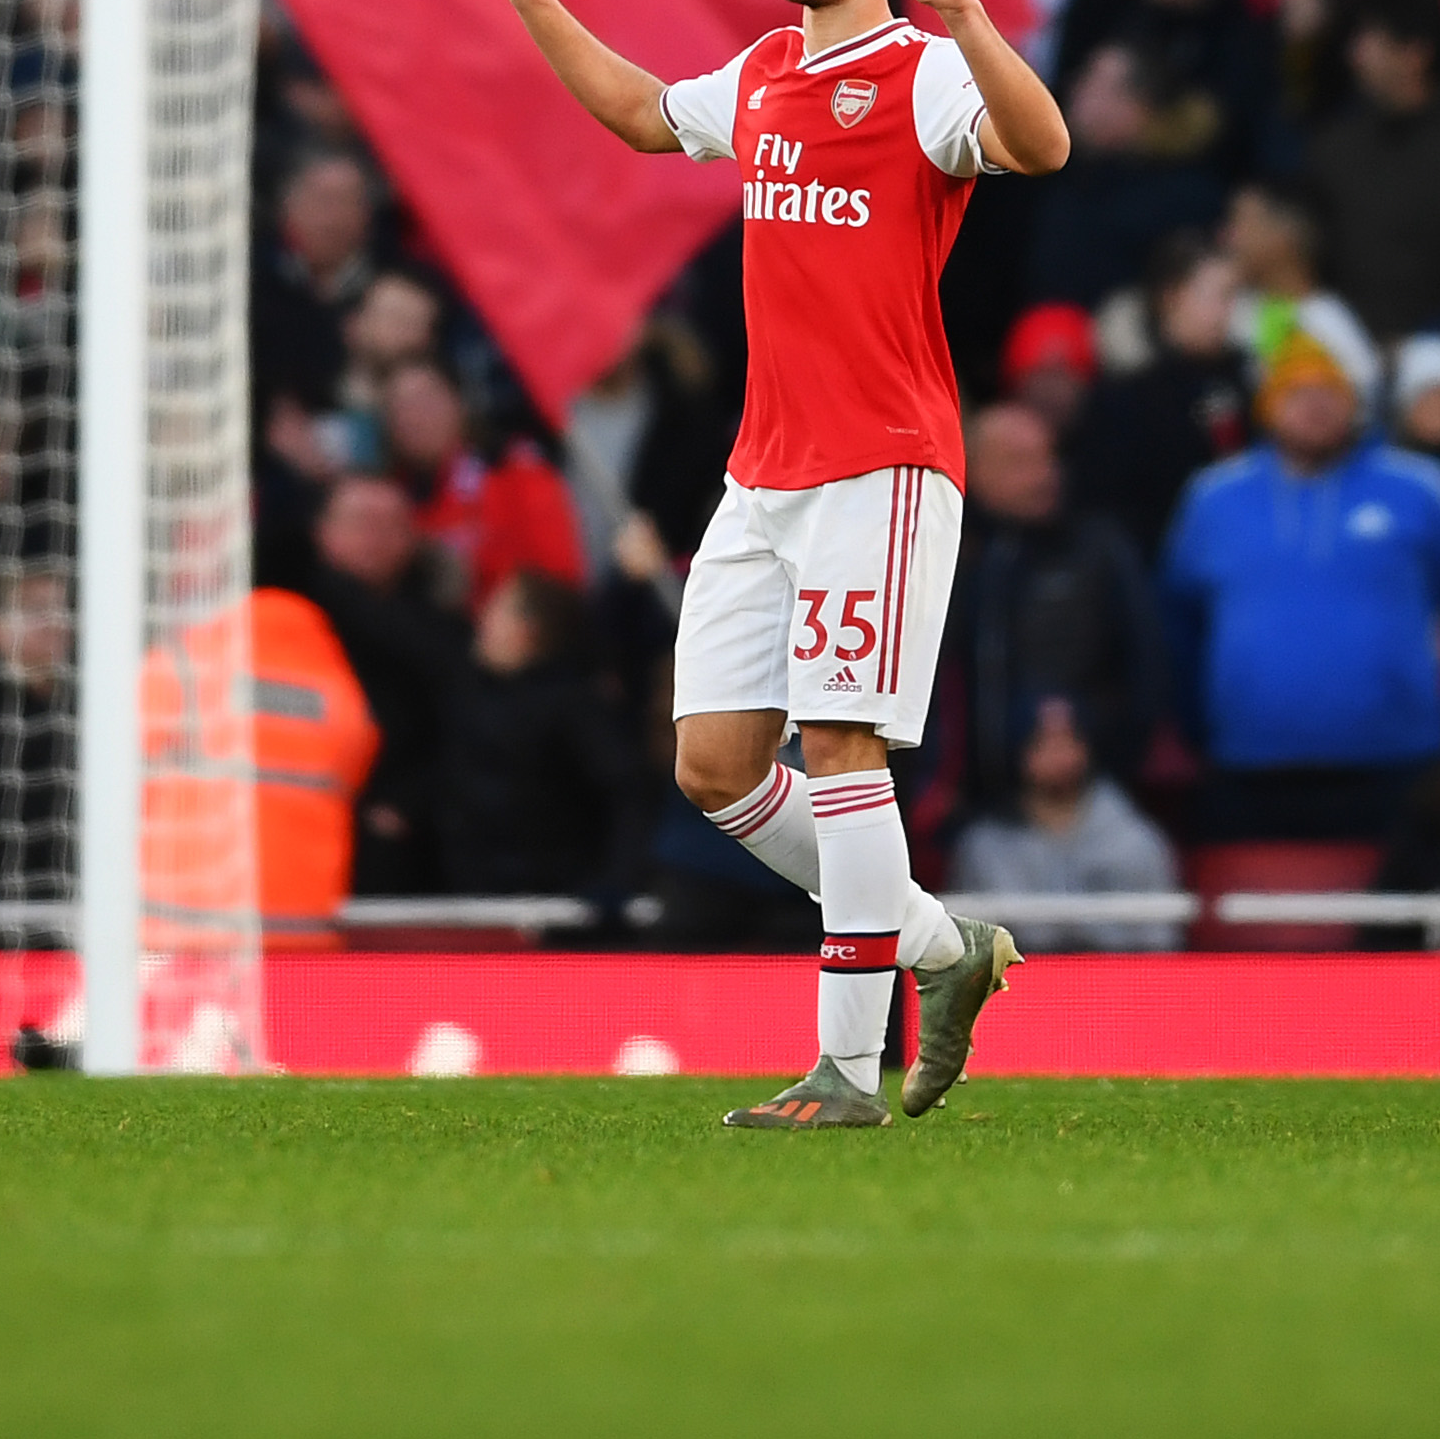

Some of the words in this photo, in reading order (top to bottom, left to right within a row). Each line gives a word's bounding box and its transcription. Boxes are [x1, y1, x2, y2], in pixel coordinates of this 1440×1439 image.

[754, 133, 802, 174] Fly
[743, 169, 871, 228] mirates
[793, 589, 877, 661] 35
[822, 681, 863, 693] adidas
[820, 943, 857, 961] FC
